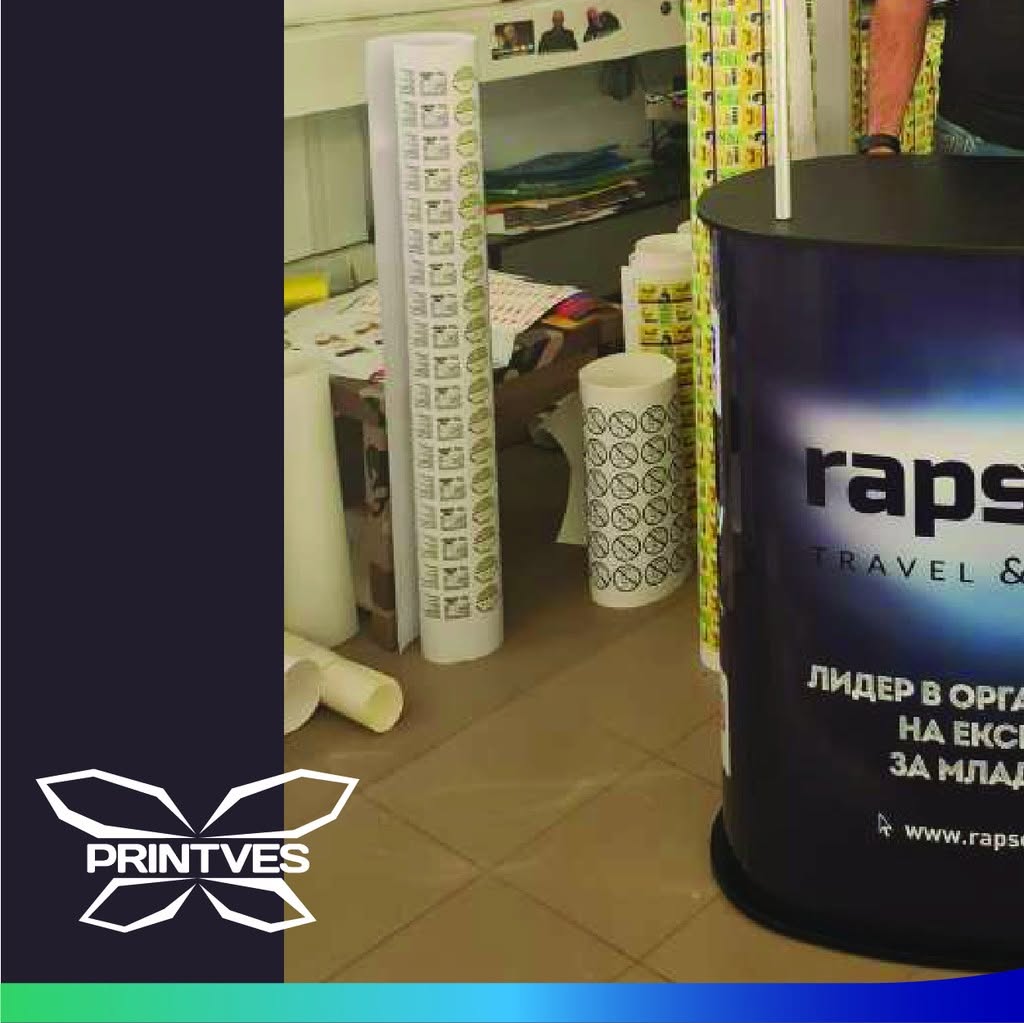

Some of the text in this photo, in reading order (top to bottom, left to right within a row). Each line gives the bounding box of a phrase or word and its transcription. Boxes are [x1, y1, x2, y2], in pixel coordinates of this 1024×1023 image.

[811, 546, 973, 583] TRAVEL
[806, 664, 915, 704] ЛИДЕР
[920, 680, 942, 706] В
[898, 714, 946, 746] НА
[888, 751, 931, 781] ЗА
